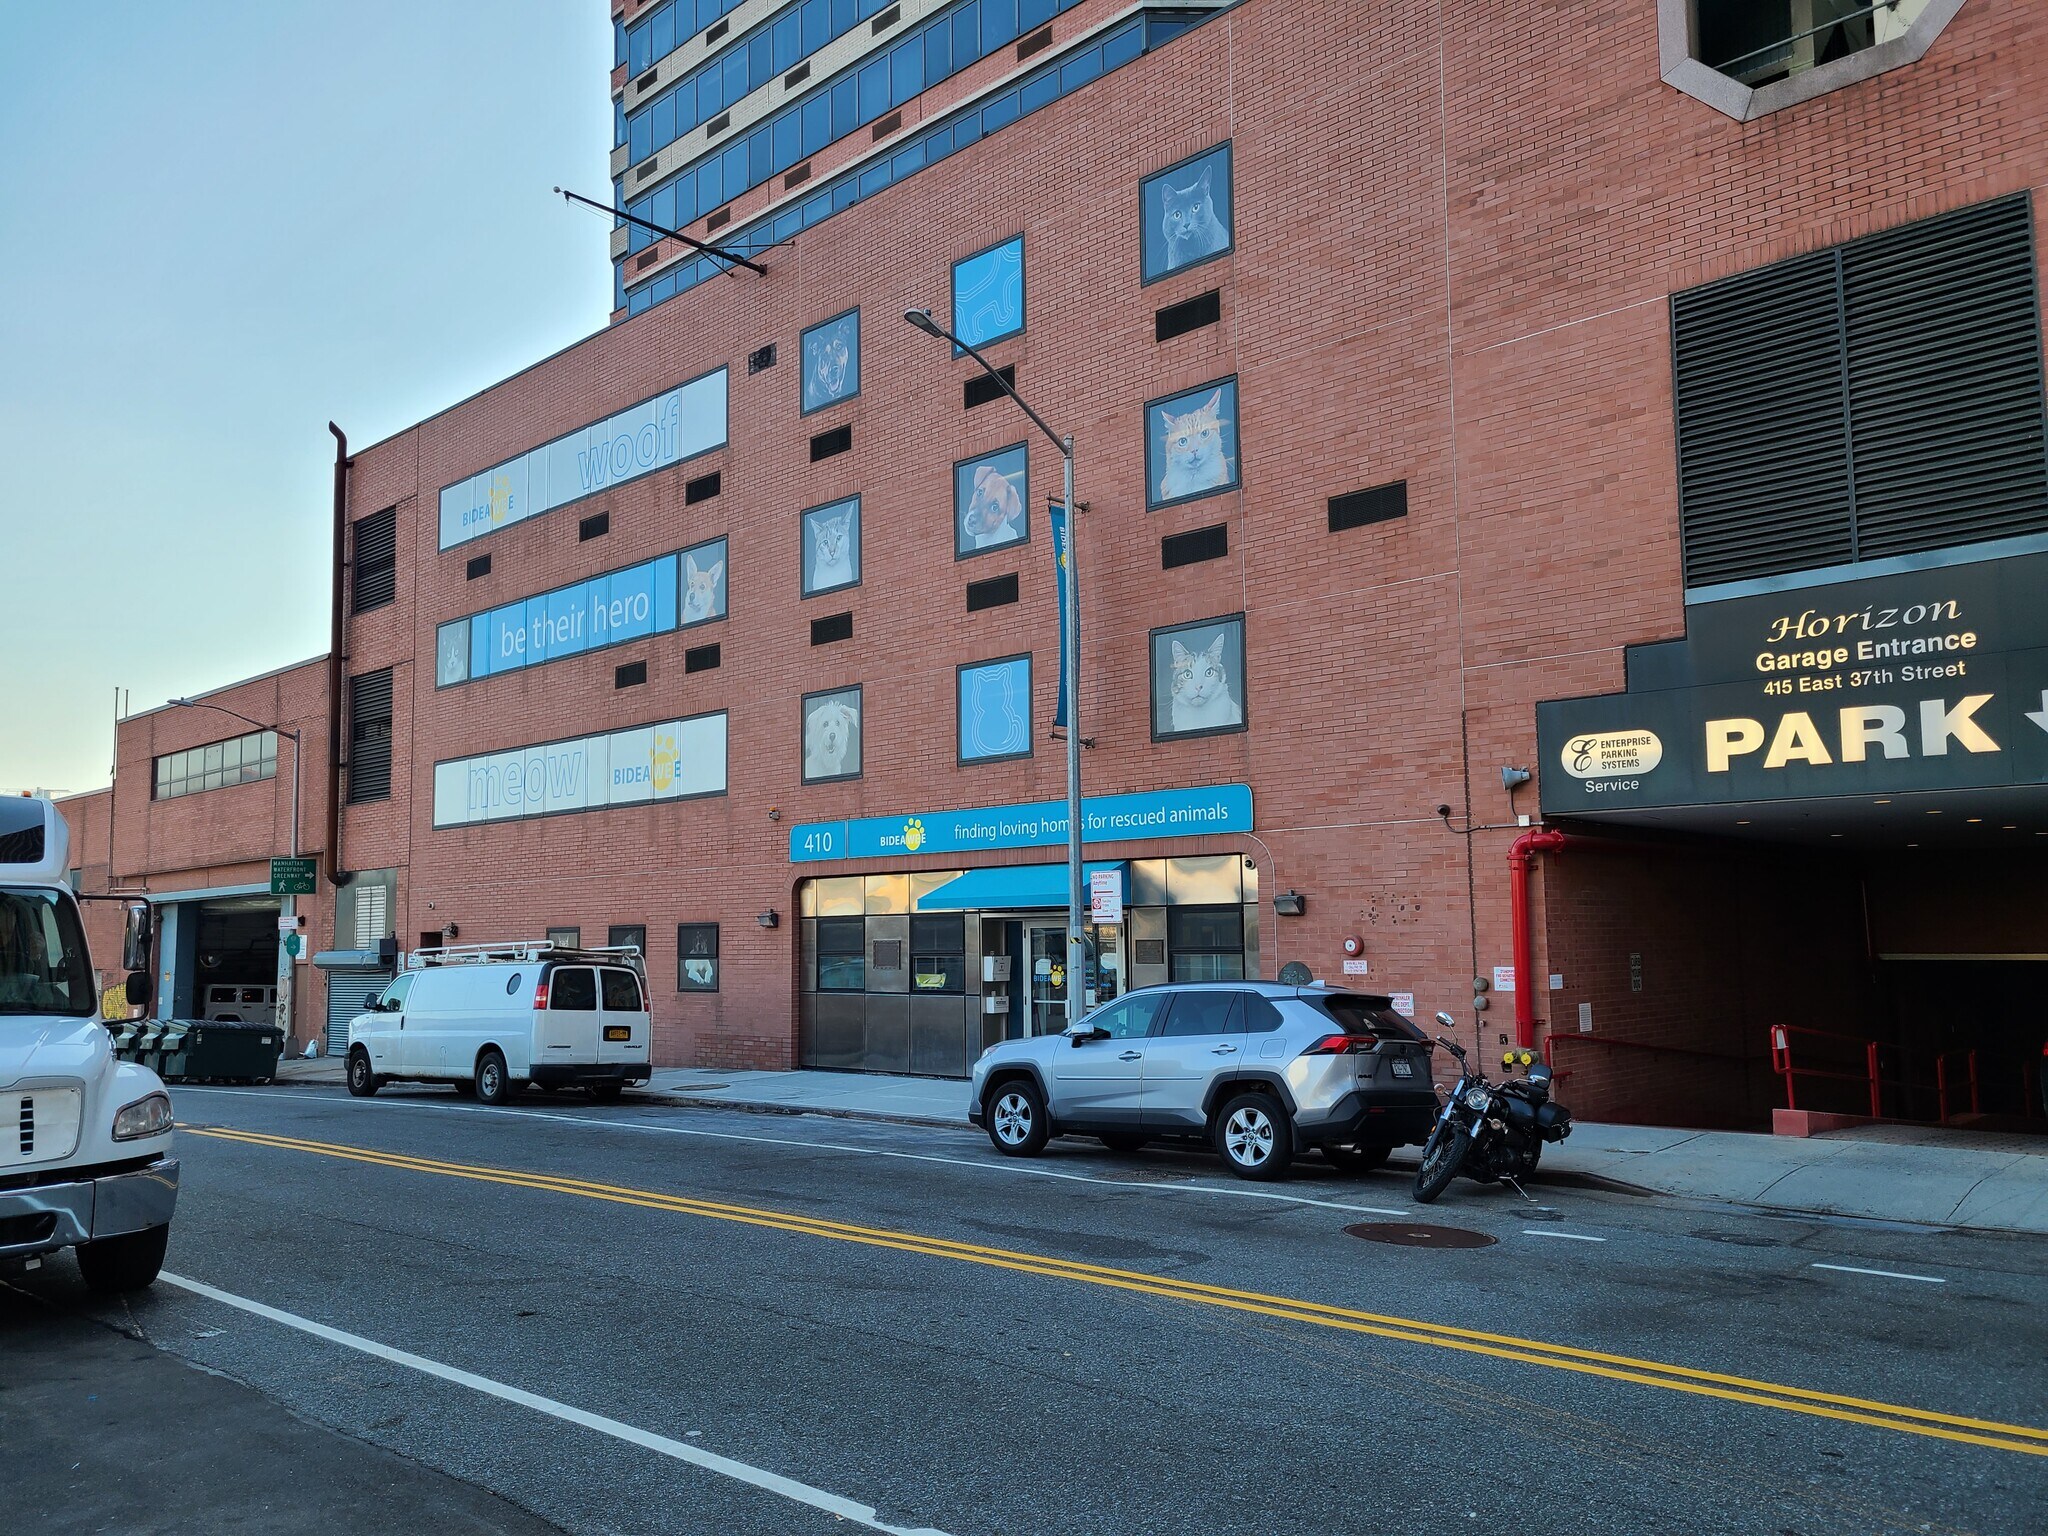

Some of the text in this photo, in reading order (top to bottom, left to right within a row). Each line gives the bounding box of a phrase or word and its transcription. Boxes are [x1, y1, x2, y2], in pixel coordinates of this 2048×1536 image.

[577, 394, 680, 491] woof
[501, 592, 649, 658] be their hero
[1766, 599, 1963, 643] Horizon
[1755, 631, 1977, 672] Garage Entrance
[1763, 660, 1966, 696] 415 East 37th Street
[1600, 736, 1651, 749] ENTERPRISE
[1704, 693, 2002, 773] PARK
[1601, 748, 1638, 759] PARKING
[1601, 758, 1640, 770] SYSTEMS
[469, 751, 582, 810] meow
[1585, 778, 1640, 793] Service
[880, 833, 927, 847] BIDEAWEE
[954, 802, 1229, 841] finding loving homs for rescued animals
[803, 832, 832, 853] 410
